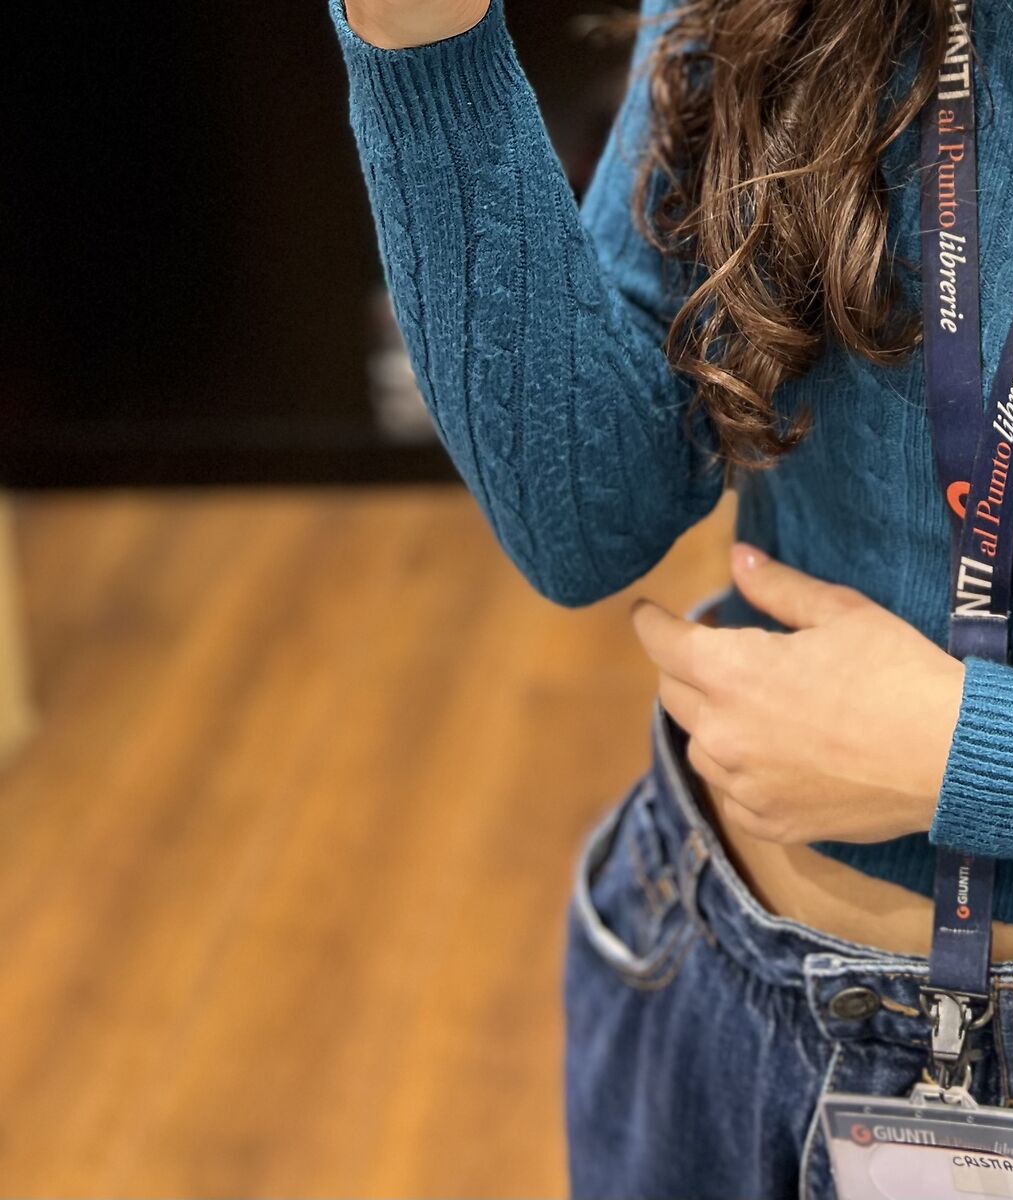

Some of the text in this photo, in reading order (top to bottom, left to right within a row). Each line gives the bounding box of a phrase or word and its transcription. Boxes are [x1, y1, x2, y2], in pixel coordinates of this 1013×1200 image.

[938, 109, 965, 135] al
[974, 528, 998, 557] al
[957, 866, 970, 905] GIUNTI
[873, 1124, 936, 1145] GIUNTI
